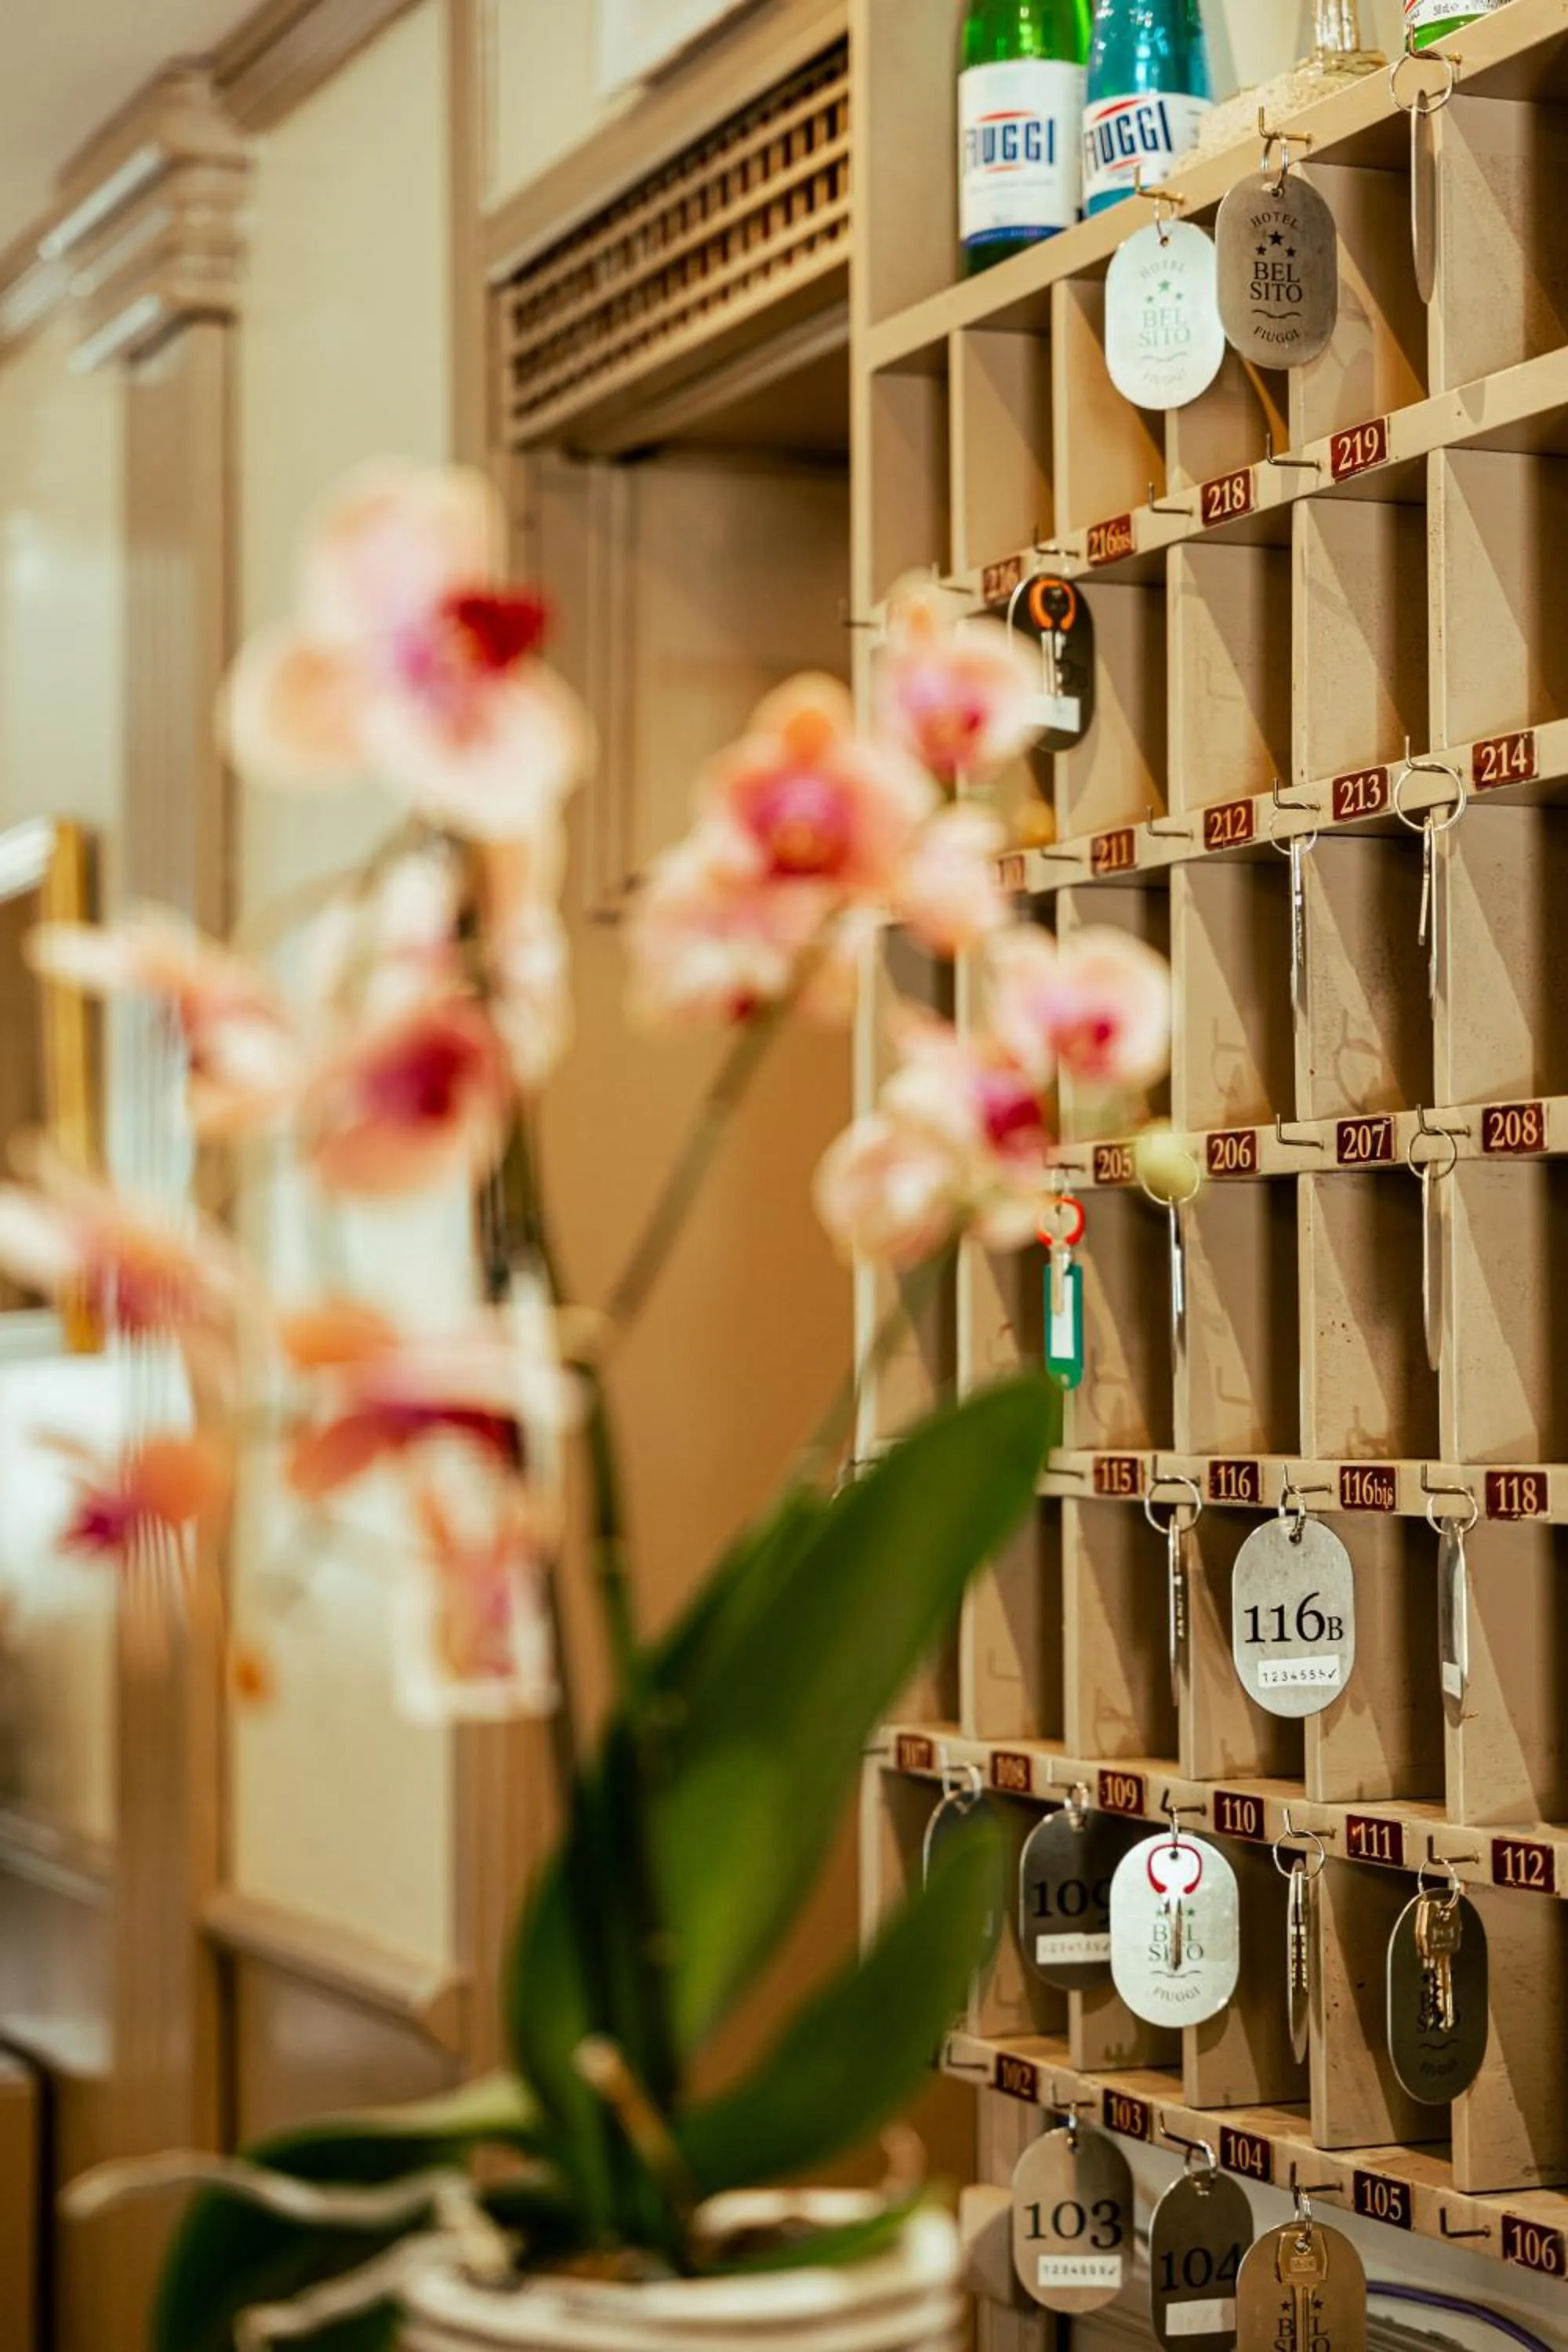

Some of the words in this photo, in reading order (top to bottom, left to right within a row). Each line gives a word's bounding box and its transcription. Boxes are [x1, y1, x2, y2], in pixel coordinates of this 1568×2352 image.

[1250, 210, 1301, 229] HOTEL
[1254, 261, 1301, 283] BEL
[1250, 281, 1303, 303] SITO
[1143, 308, 1188, 328] BEL
[1254, 325, 1301, 344] FIUGGI
[1138, 327, 1191, 348] SITO
[1338, 426, 1378, 471] 219
[1208, 478, 1245, 518] 218
[1481, 738, 1526, 782] 214
[1340, 773, 1381, 815] 213
[1210, 807, 1247, 844] 212
[1098, 834, 1129, 869] 211
[1343, 1124, 1387, 1160] 207
[1490, 1109, 1537, 1147] 208
[1098, 1148, 1134, 1179] 205
[1212, 1138, 1250, 1171] 206
[1100, 1461, 1131, 1492] 115
[1217, 1466, 1250, 1498] 116
[1342, 1470, 1393, 1508] 116bis
[1497, 1477, 1537, 1513] 118
[1244, 1592, 1344, 1642] 116B
[1104, 1775, 1137, 1809] 109
[1223, 1795, 1255, 1834] 110
[1357, 1822, 1392, 1860] 111
[1503, 1846, 1544, 1886] 112
[1153, 1923, 1202, 1942] BL
[1148, 1943, 1203, 1962] SIO
[1109, 2096, 1142, 2134] 103
[1227, 2134, 1263, 2176] 104
[1362, 2178, 1403, 2221] 105
[1024, 2199, 1122, 2249] 103
[1511, 2224, 1556, 2270] 106
[1159, 2243, 1240, 2292] 104
[1274, 2337, 1330, 2352] SIO
[1278, 2318, 1328, 2337] BL
